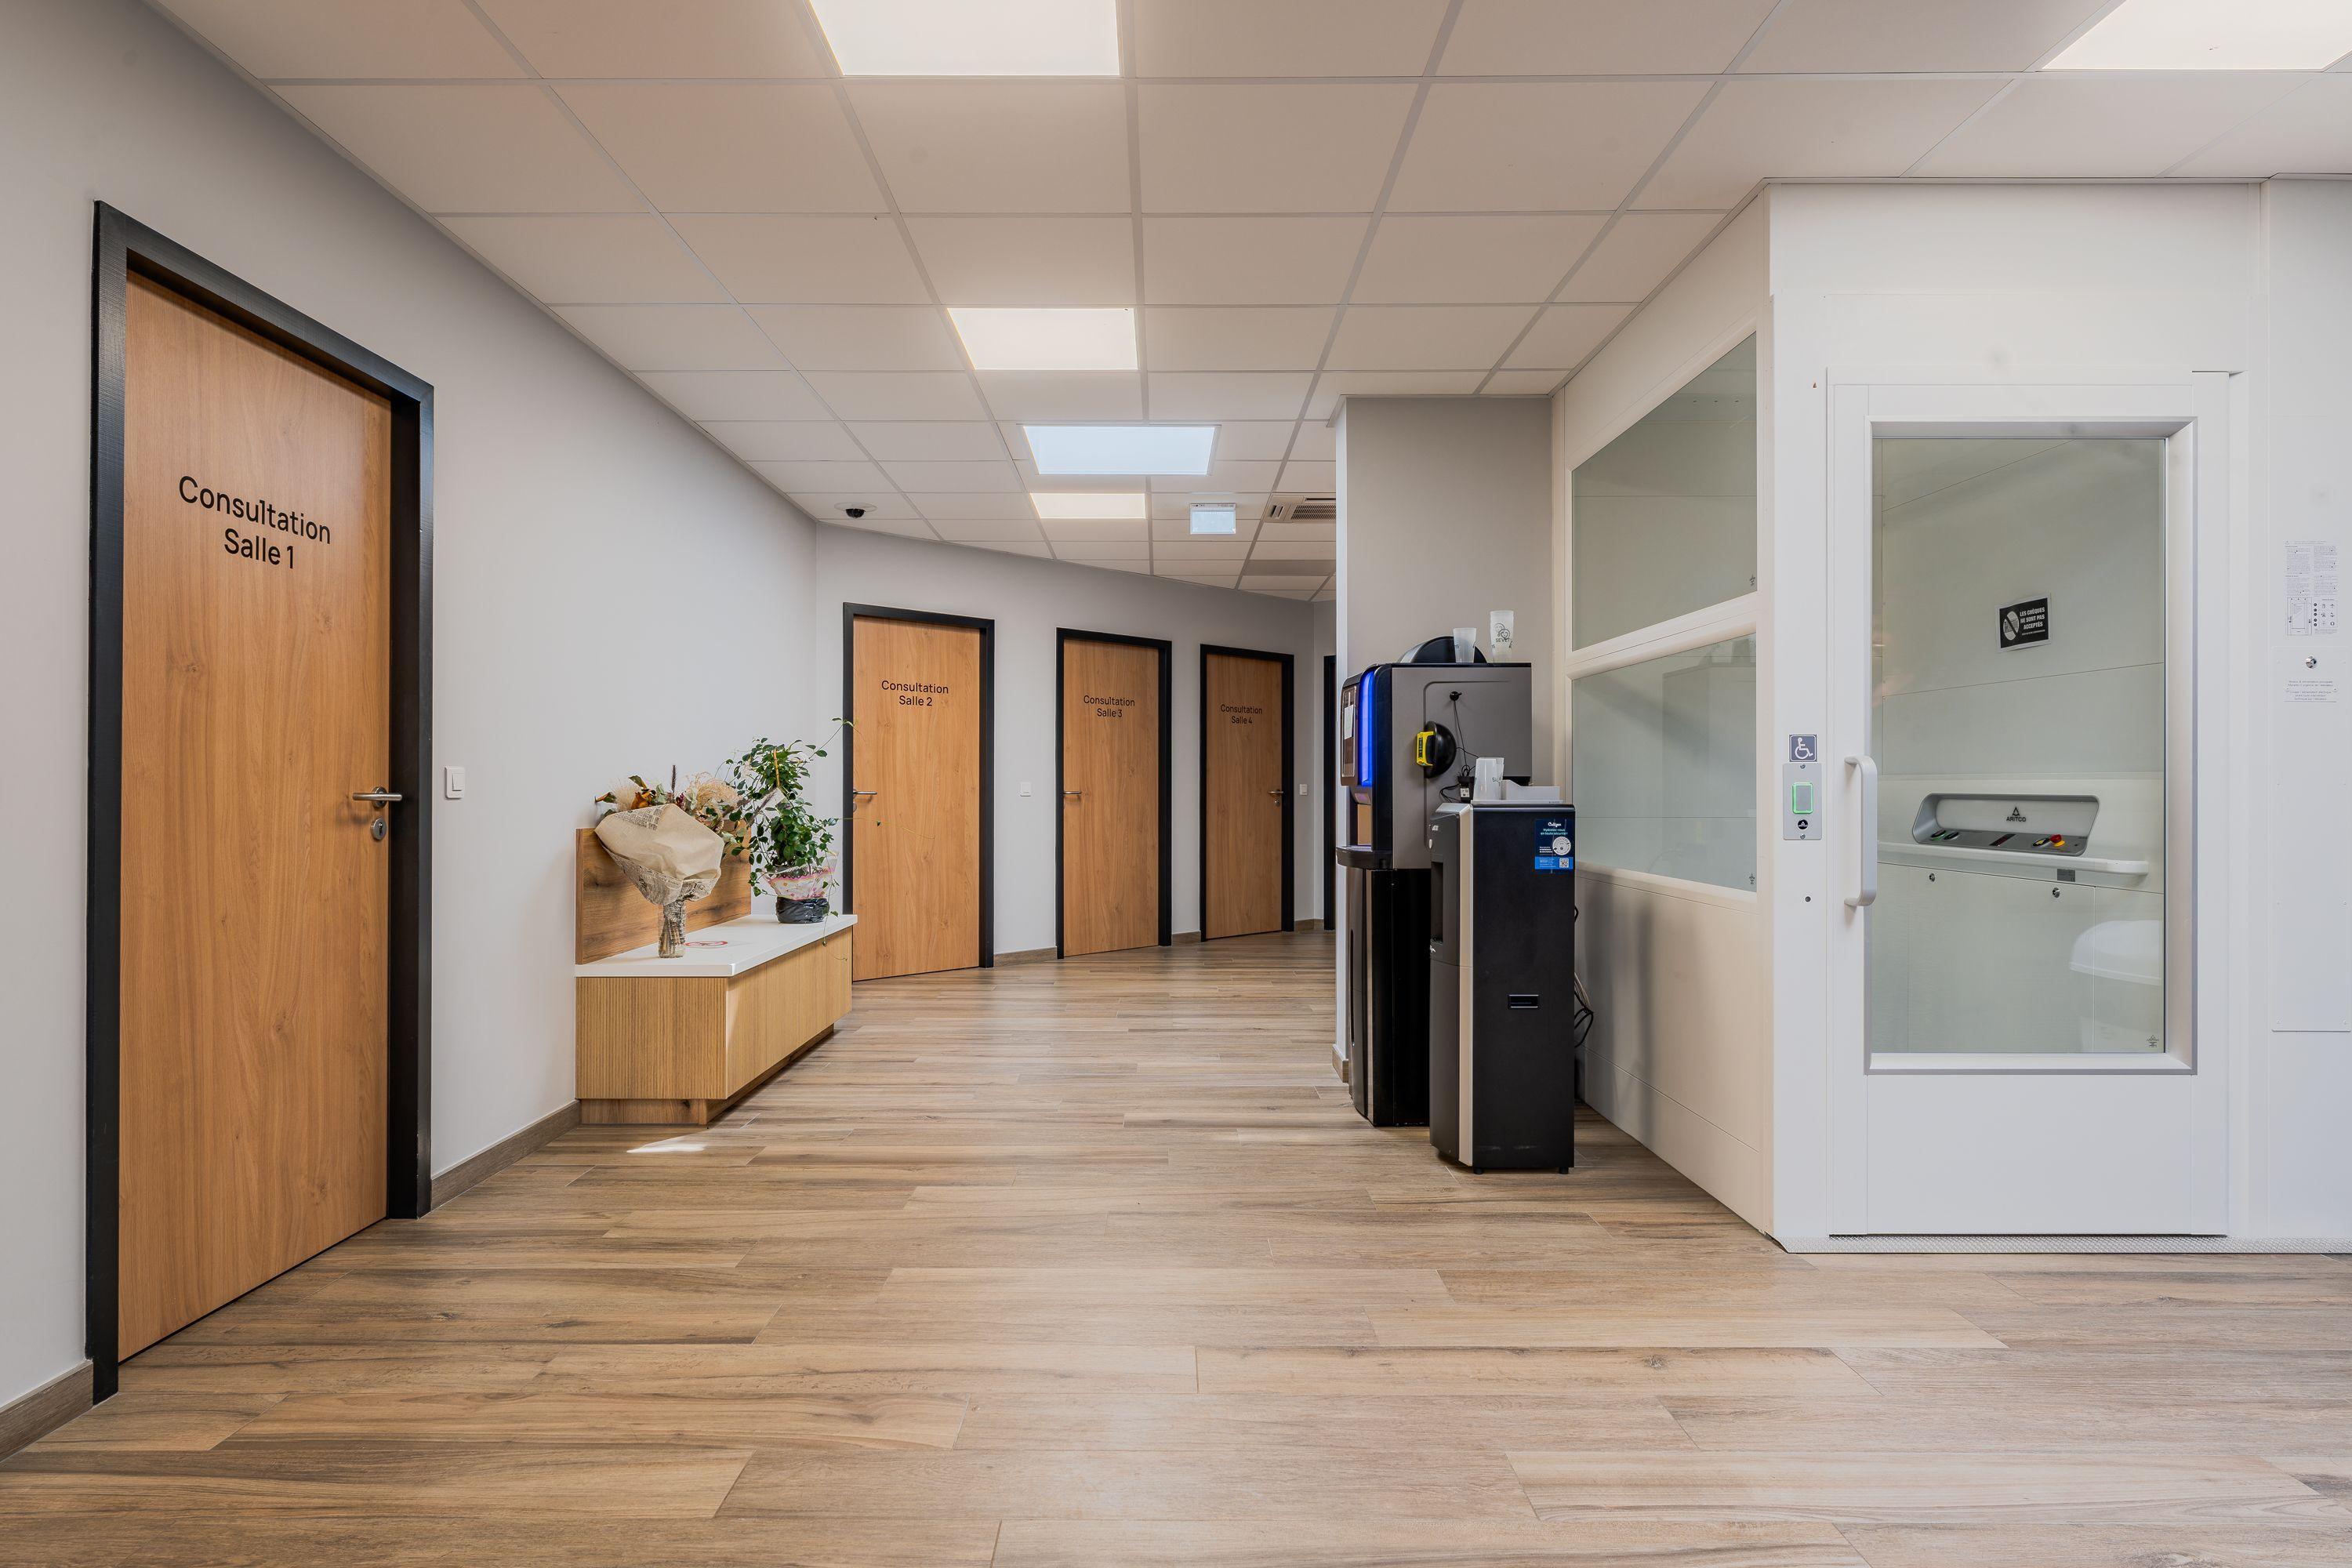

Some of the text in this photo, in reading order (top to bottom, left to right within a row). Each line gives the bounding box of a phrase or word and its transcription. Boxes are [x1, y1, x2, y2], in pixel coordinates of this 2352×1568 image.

[179, 475, 331, 544] Consultation
[224, 528, 294, 569] Salle 1
[2024, 620, 2043, 630] ACCEPTÉS
[881, 680, 949, 694] Consultation
[898, 695, 933, 706] Salle 2
[1083, 695, 1135, 706] Consultation
[1097, 708, 1123, 718] Salle 3
[1220, 703, 1263, 714] Consultation
[1231, 715, 1247, 724] Salle
